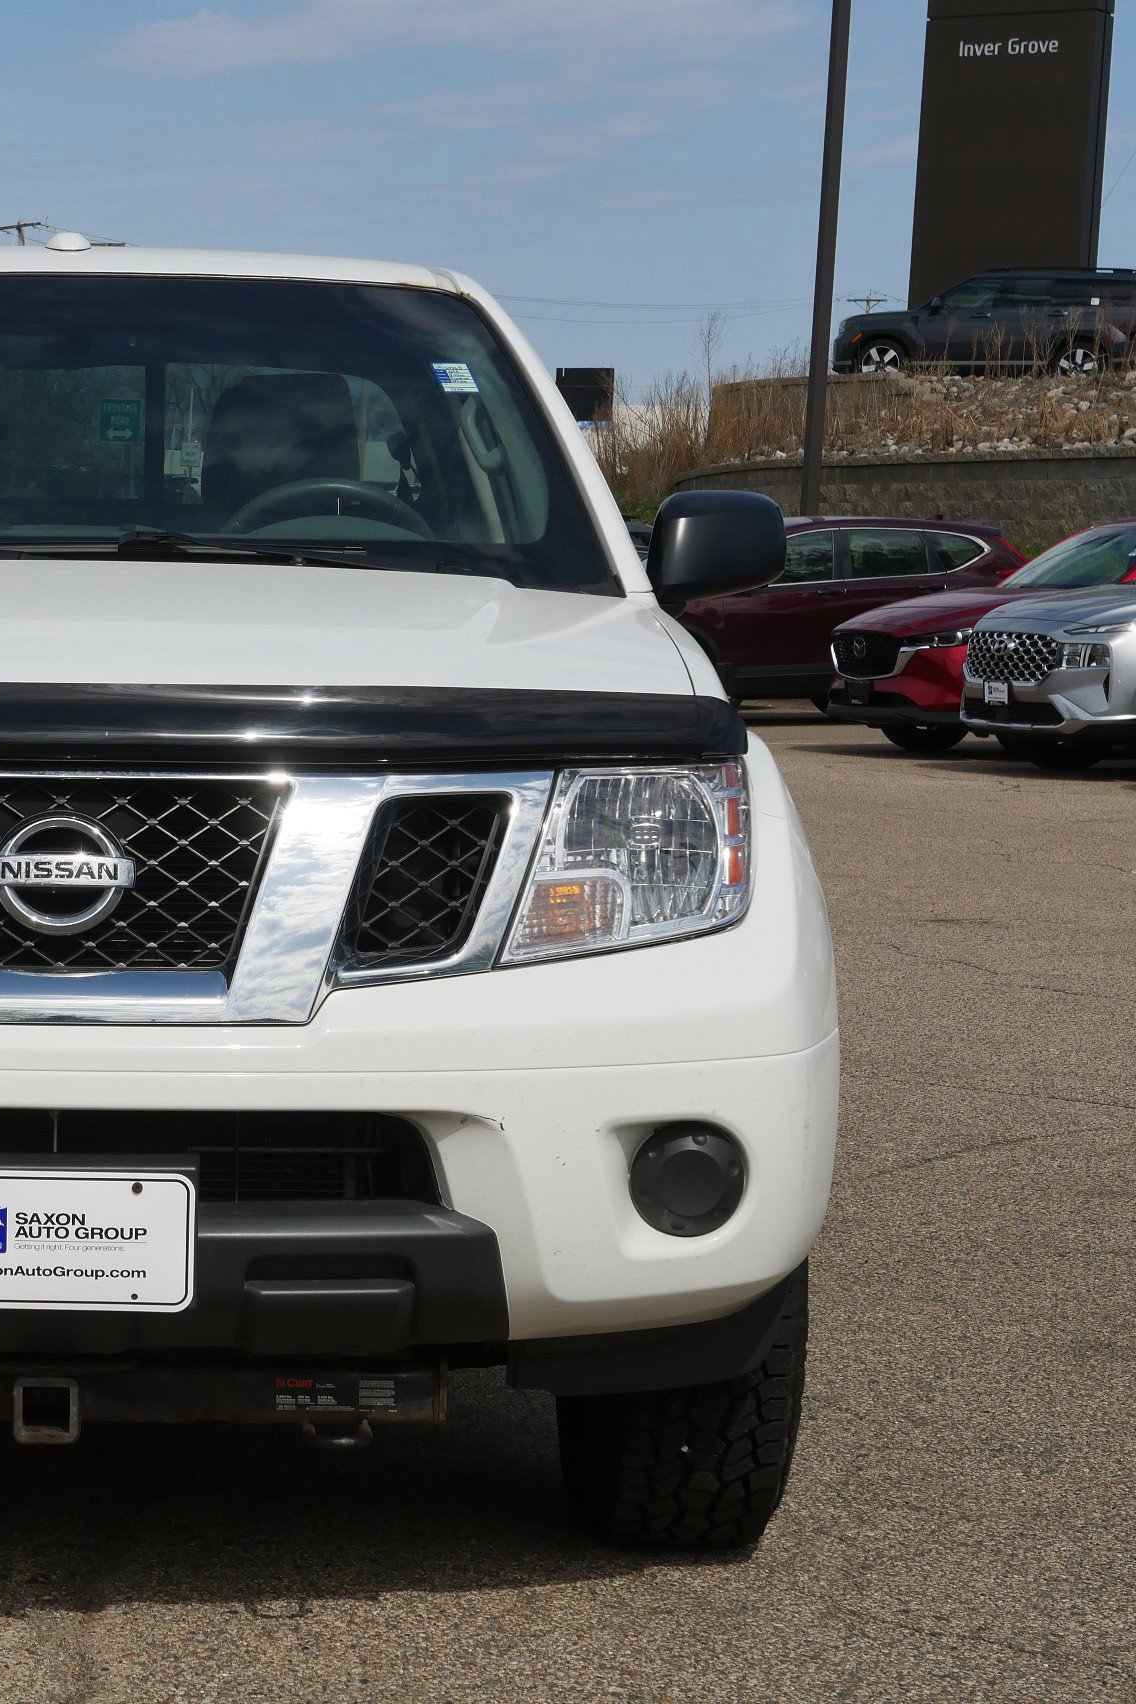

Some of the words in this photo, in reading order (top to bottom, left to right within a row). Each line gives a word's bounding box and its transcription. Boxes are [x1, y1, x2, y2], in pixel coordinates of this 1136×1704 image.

[959, 40, 1002, 57] Inver
[1007, 38, 1059, 55] Grove
[103, 402, 138, 414] FRONTAGE
[110, 416, 130, 425] ROAD
[0, 861, 119, 881] NISSAN
[15, 1211, 86, 1226] SAXON
[15, 1226, 70, 1239] AUTO
[74, 1226, 148, 1240] GROUP
[14, 1242, 40, 1251] Getting
